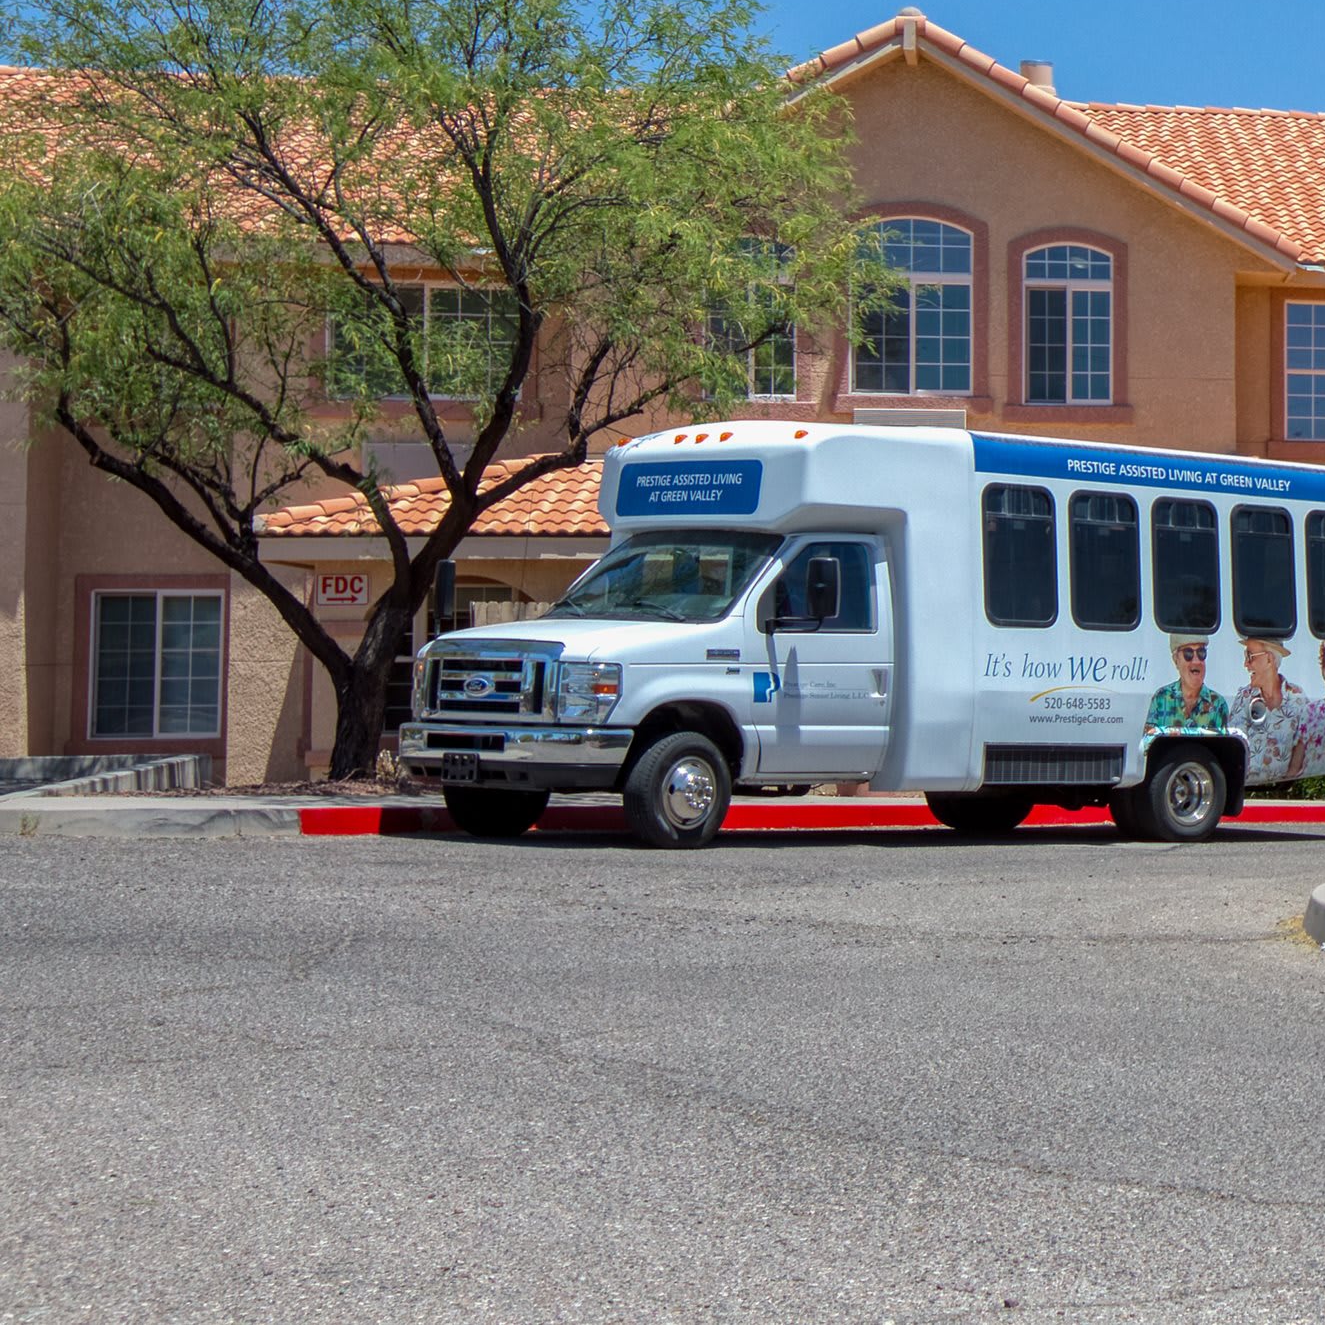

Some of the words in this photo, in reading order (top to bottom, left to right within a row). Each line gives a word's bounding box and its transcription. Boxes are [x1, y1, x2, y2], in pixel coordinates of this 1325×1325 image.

[636, 475, 672, 487] PRESTIGE
[672, 474, 711, 486] ASSISTED
[712, 472, 743, 485] LIVING
[1067, 459, 1116, 475] PRESTIGE
[1119, 464, 1166, 480] ASSISTED
[1168, 469, 1202, 483] LIVING
[1205, 472, 1218, 484] AT
[1220, 474, 1252, 488] GREEN
[1254, 477, 1291, 492] VALLEY
[648, 491, 660, 503] AT
[660, 490, 688, 502] GREEN
[689, 489, 723, 501] VALLEY
[322, 576, 364, 595] FDC
[984, 652, 1012, 678] It's
[1021, 652, 1062, 679] how
[1111, 656, 1149, 681] roll!
[1044, 697, 1111, 710] 520-648-5583
[1029, 714, 1124, 726] www.PrestigeCare.com
